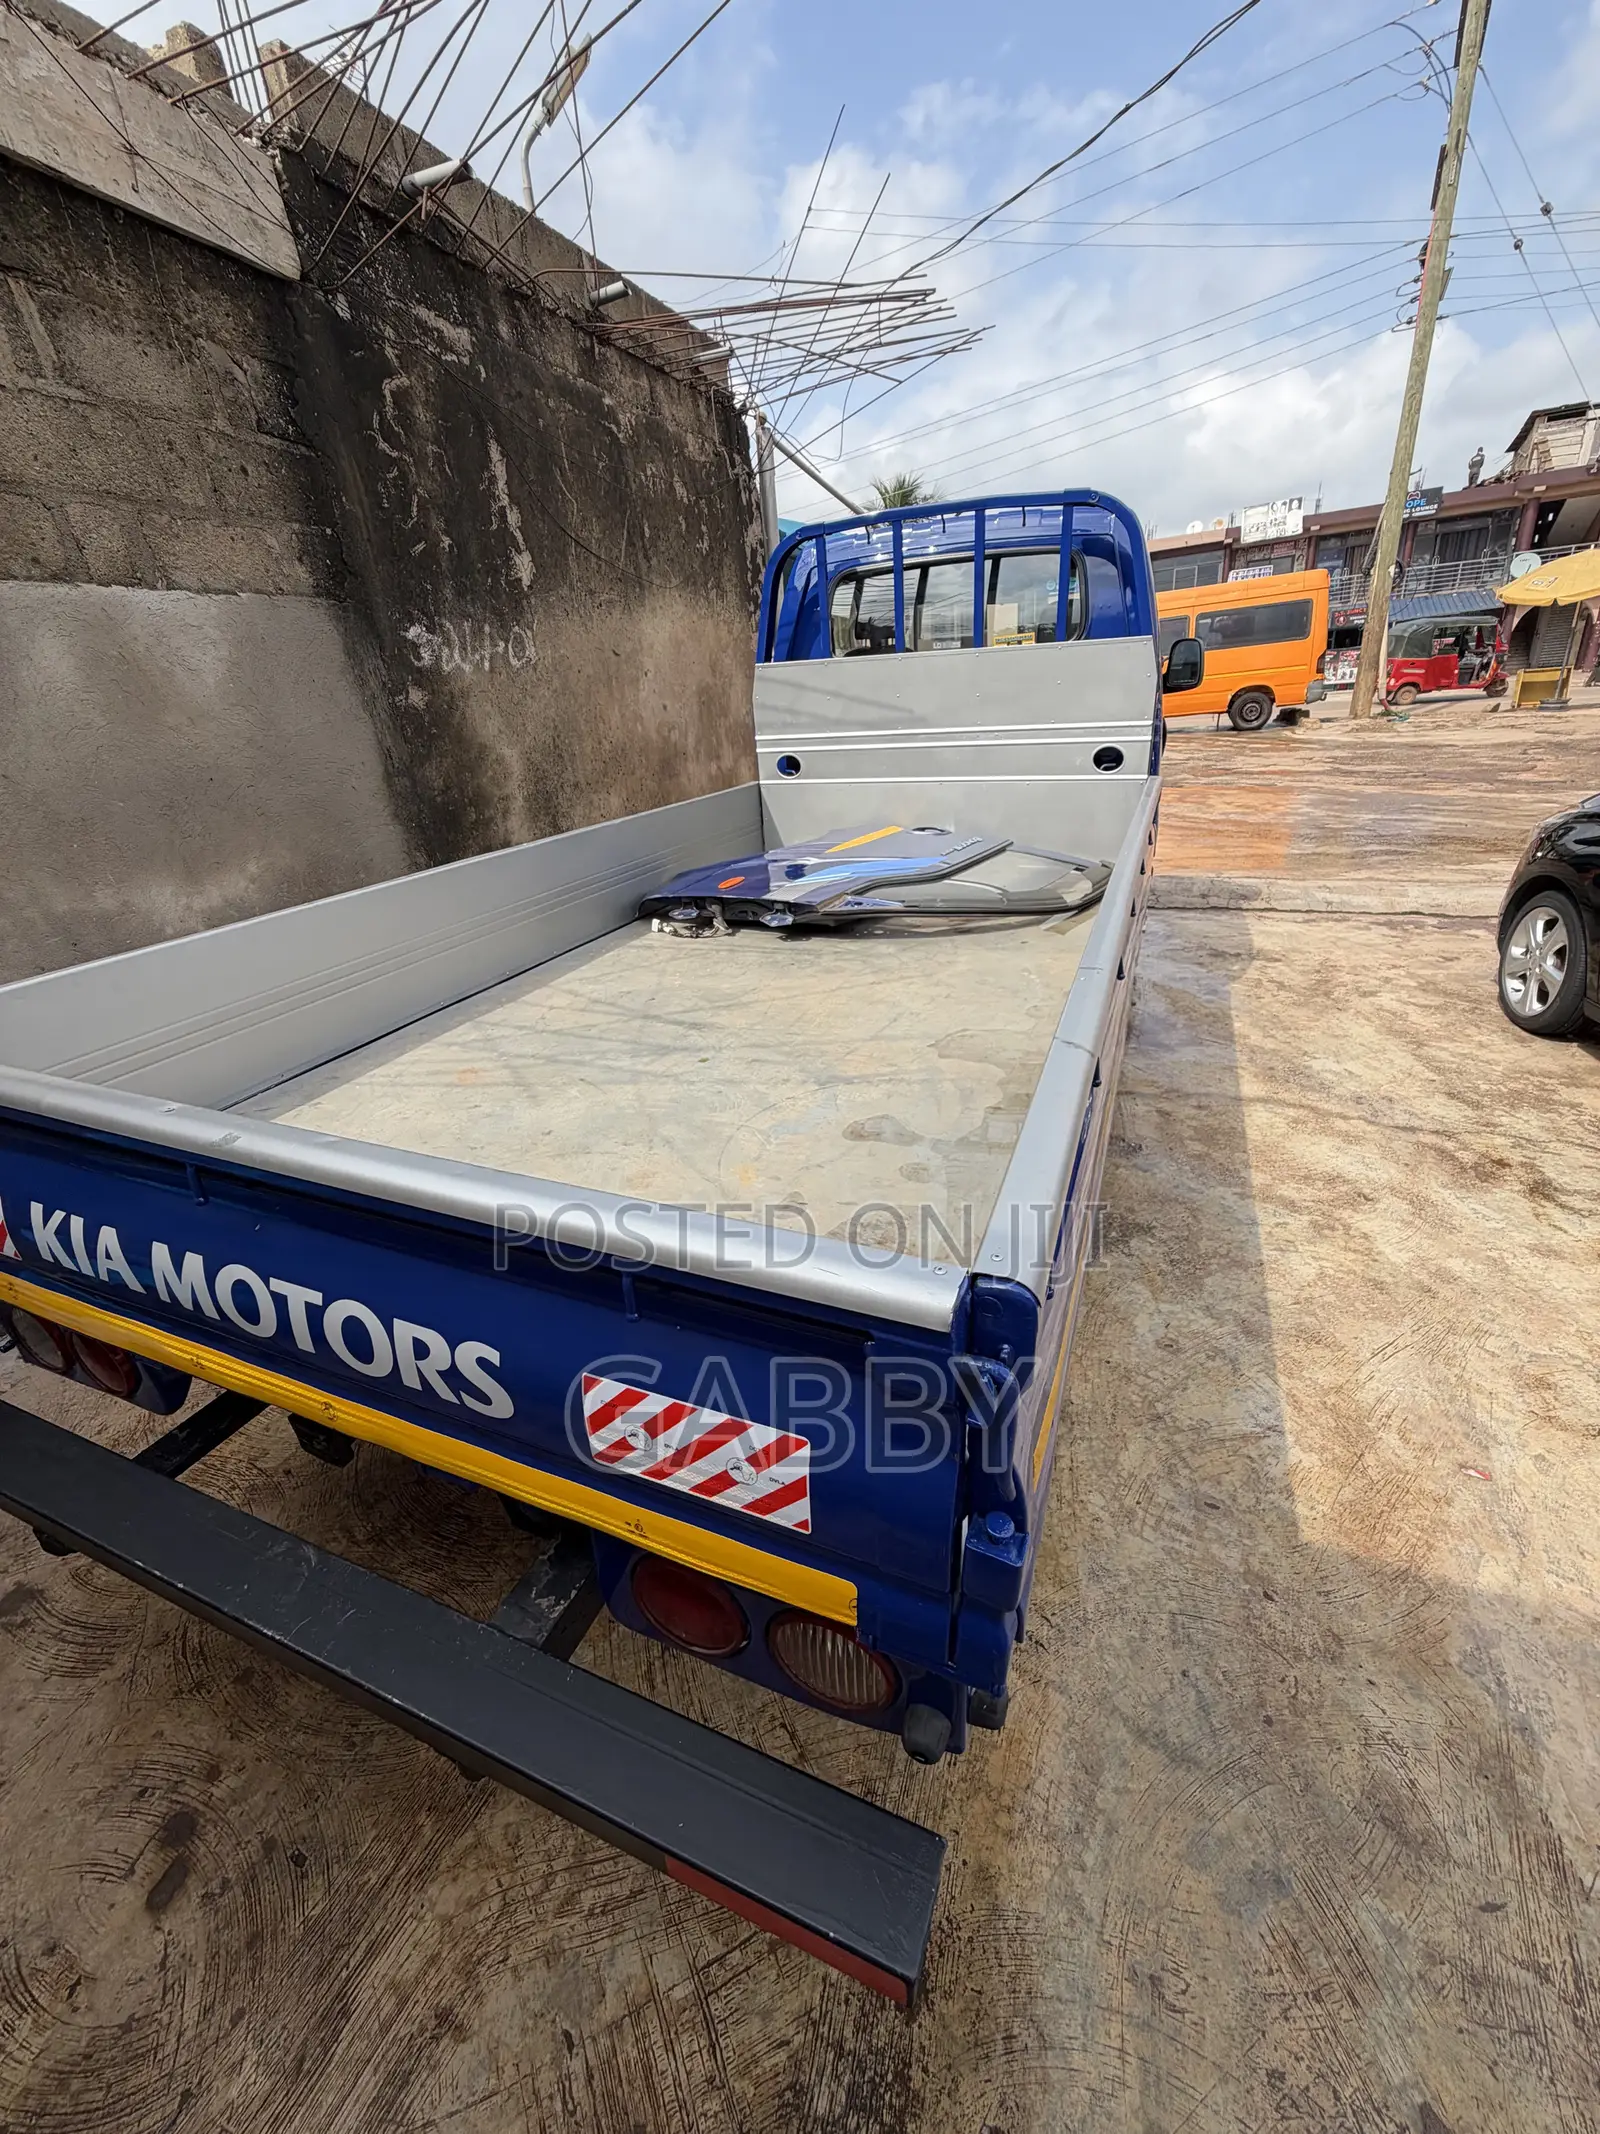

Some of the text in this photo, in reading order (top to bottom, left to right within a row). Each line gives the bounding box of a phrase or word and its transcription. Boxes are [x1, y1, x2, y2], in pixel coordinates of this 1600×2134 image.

[1412, 503, 1439, 512] LOUNGE
[30, 1201, 515, 1420] KIA MOTORS
